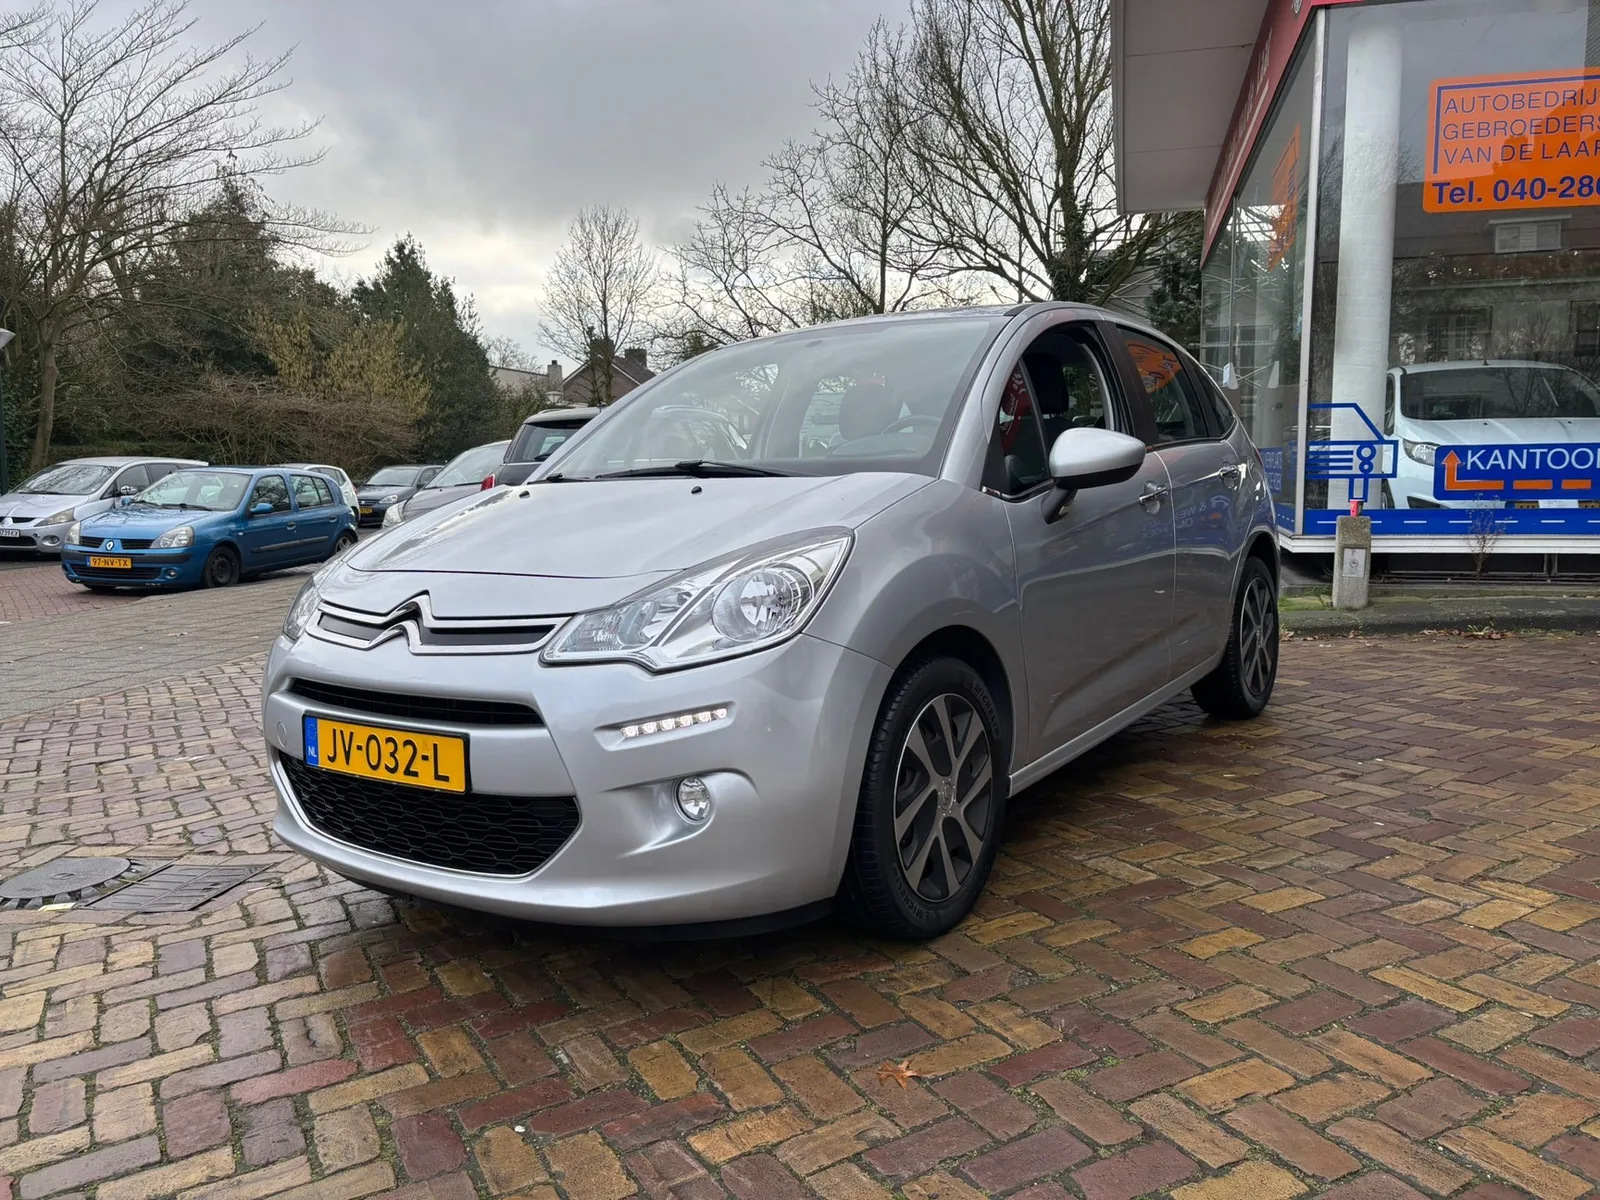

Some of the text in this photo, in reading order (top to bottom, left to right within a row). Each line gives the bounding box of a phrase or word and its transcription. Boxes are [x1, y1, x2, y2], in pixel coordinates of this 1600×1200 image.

[1444, 146, 1492, 164] VAN
[1500, 143, 1533, 162] DE
[1432, 174, 1600, 204] Tel. 040-28
[1466, 447, 1600, 470] KANTOO
[92, 557, 128, 567] 97-NV-TX
[308, 728, 450, 783] NL JV-032-L
